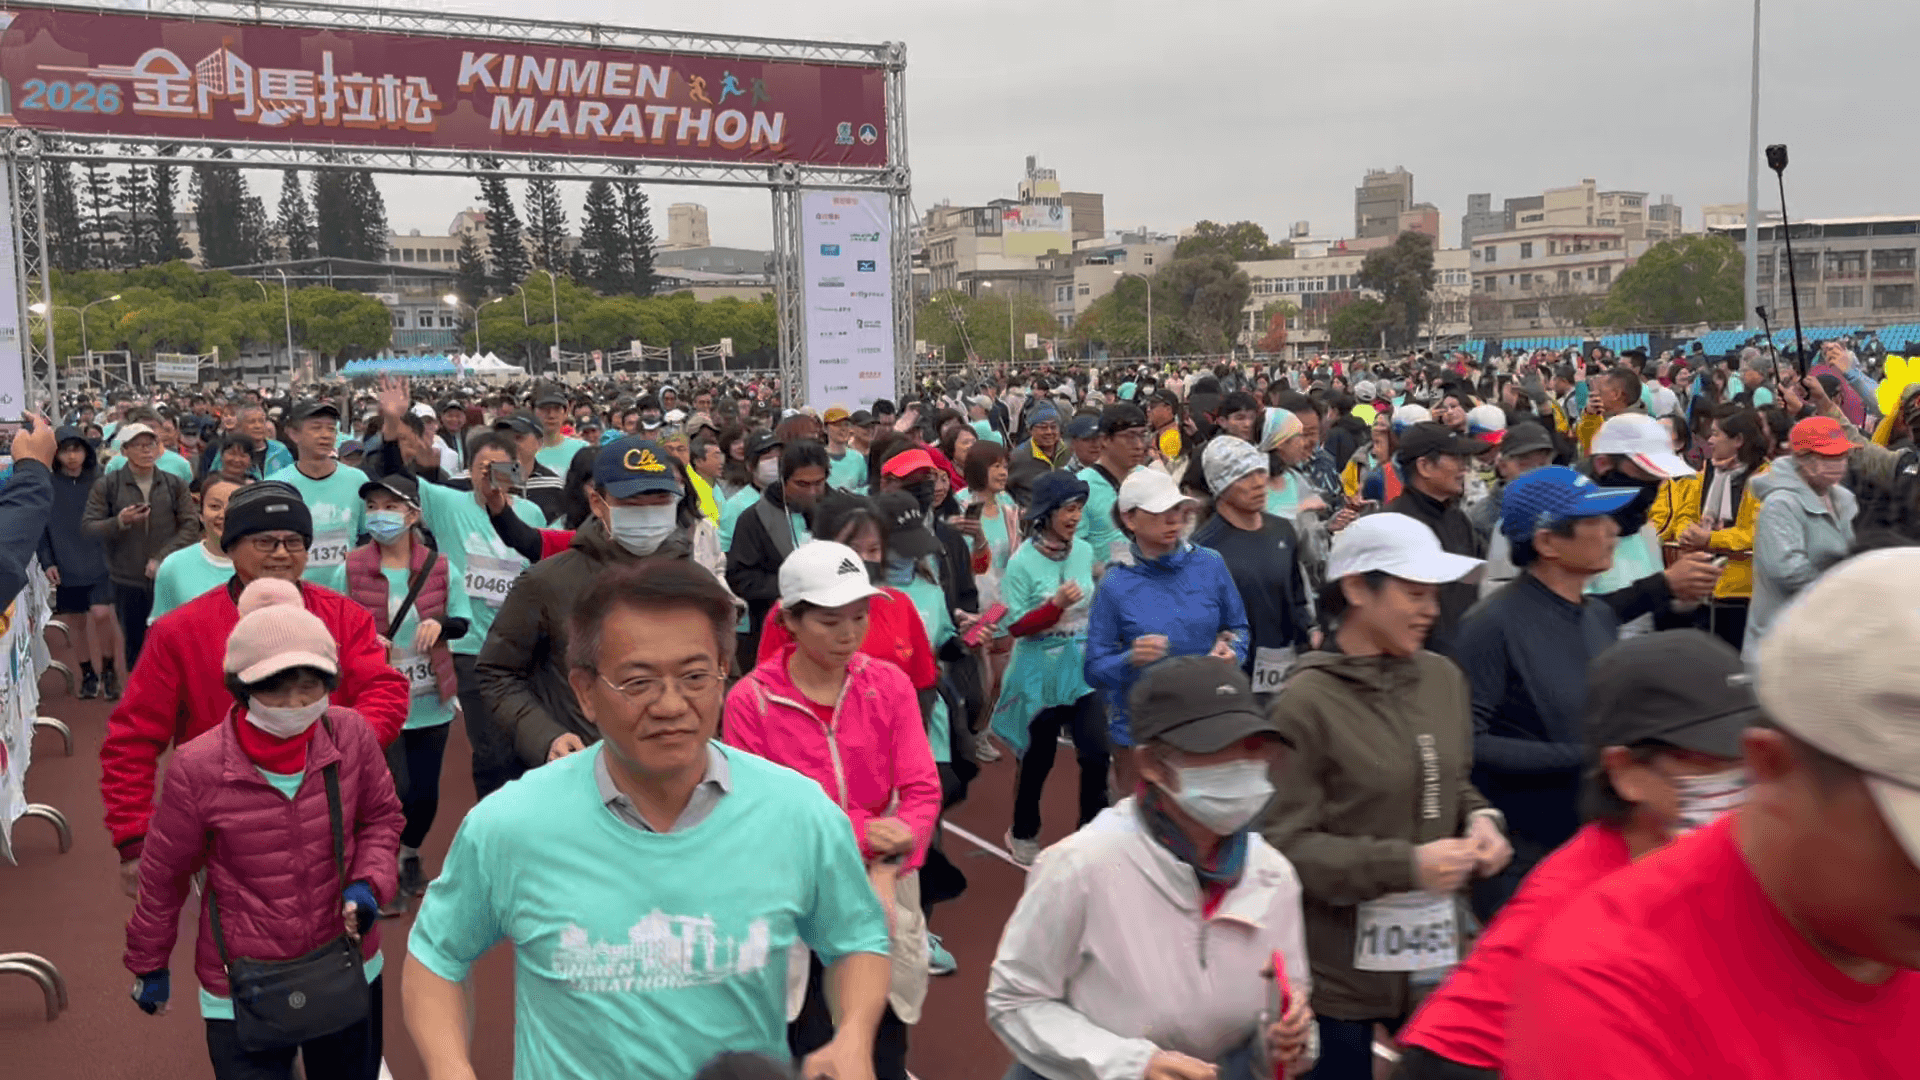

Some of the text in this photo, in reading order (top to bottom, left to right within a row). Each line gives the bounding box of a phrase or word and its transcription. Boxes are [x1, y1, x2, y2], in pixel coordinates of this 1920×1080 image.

[23, 46, 439, 128] 2026 金門馬拉松
[457, 52, 673, 100] KINMEN
[490, 96, 785, 146] MARATHON
